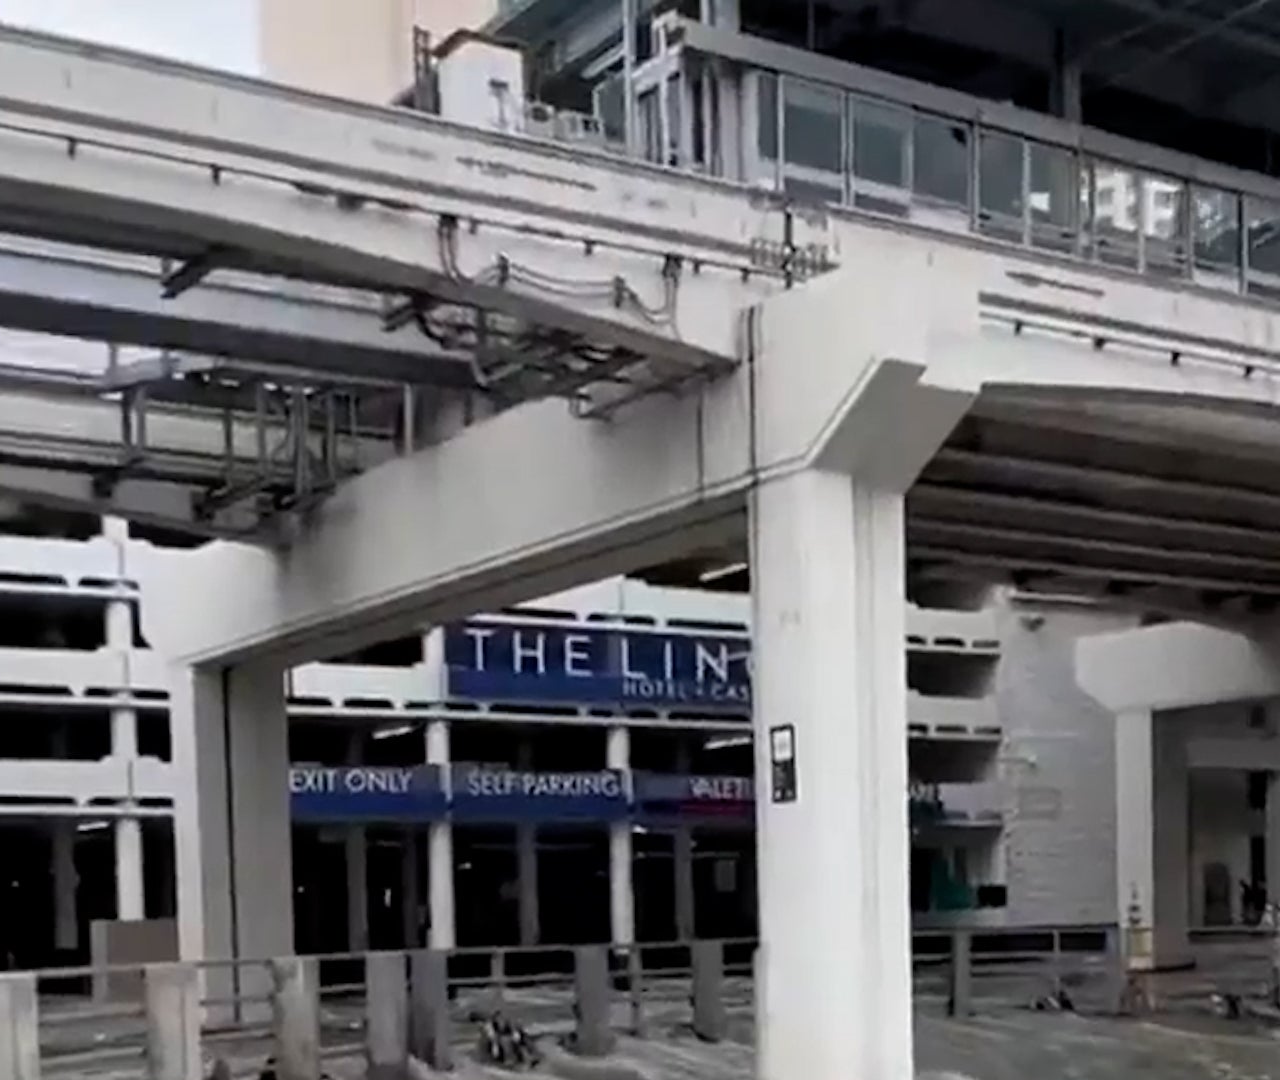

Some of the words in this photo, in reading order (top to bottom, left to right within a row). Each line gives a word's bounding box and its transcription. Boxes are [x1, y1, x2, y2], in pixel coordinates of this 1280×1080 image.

[464, 628, 593, 677] THE
[621, 636, 753, 682] LIN
[622, 678, 686, 699] HOTEL
[288, 768, 336, 793] EXIT
[345, 768, 413, 793] ONLY
[468, 769, 516, 796] SELF
[521, 772, 620, 797] PARKING
